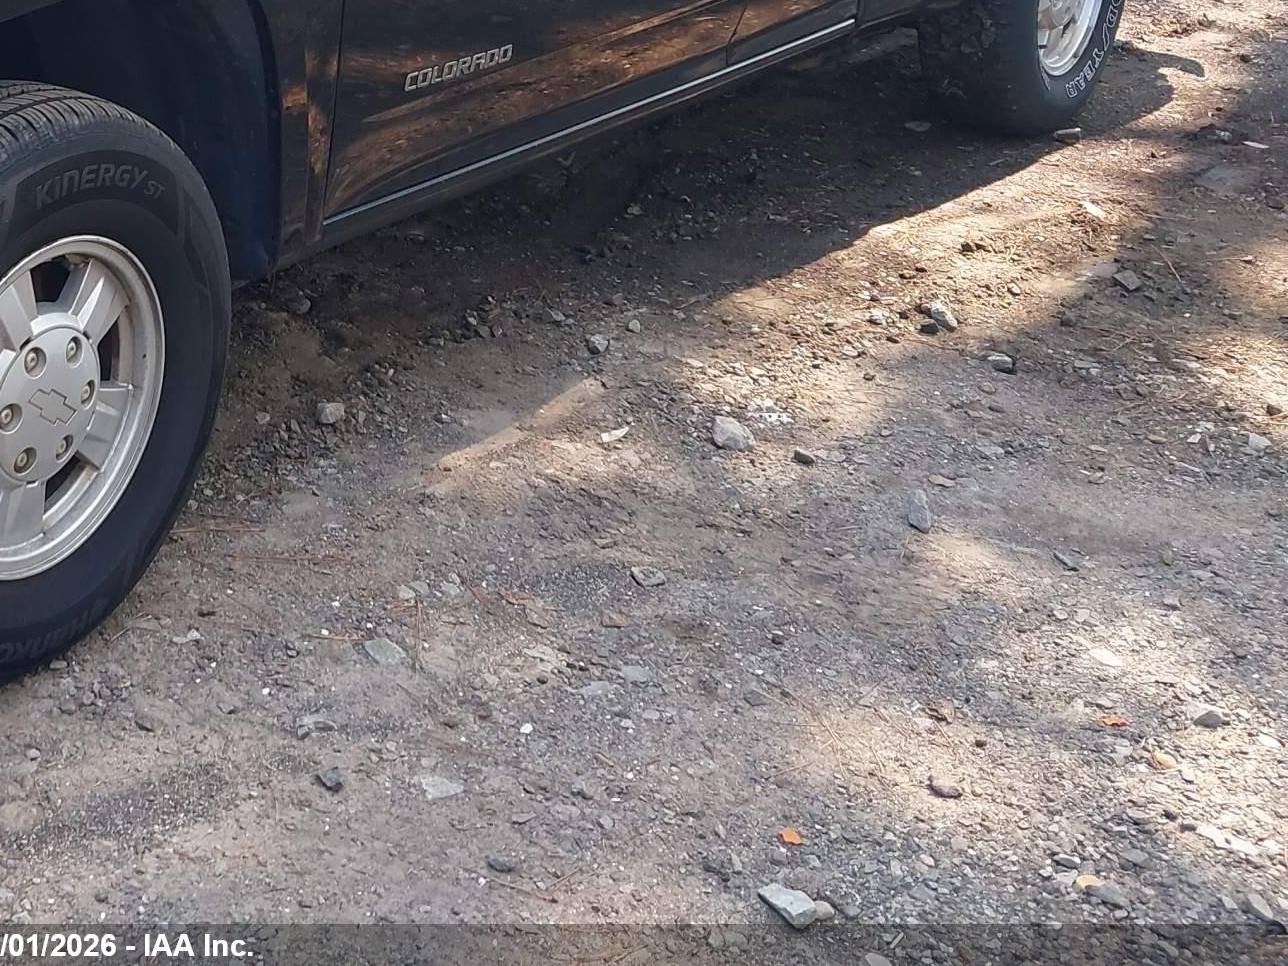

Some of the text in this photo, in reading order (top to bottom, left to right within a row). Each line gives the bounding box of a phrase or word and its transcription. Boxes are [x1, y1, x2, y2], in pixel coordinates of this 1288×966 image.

[404, 44, 513, 92] COLORADO
[36, 163, 166, 211] KINERGY ST
